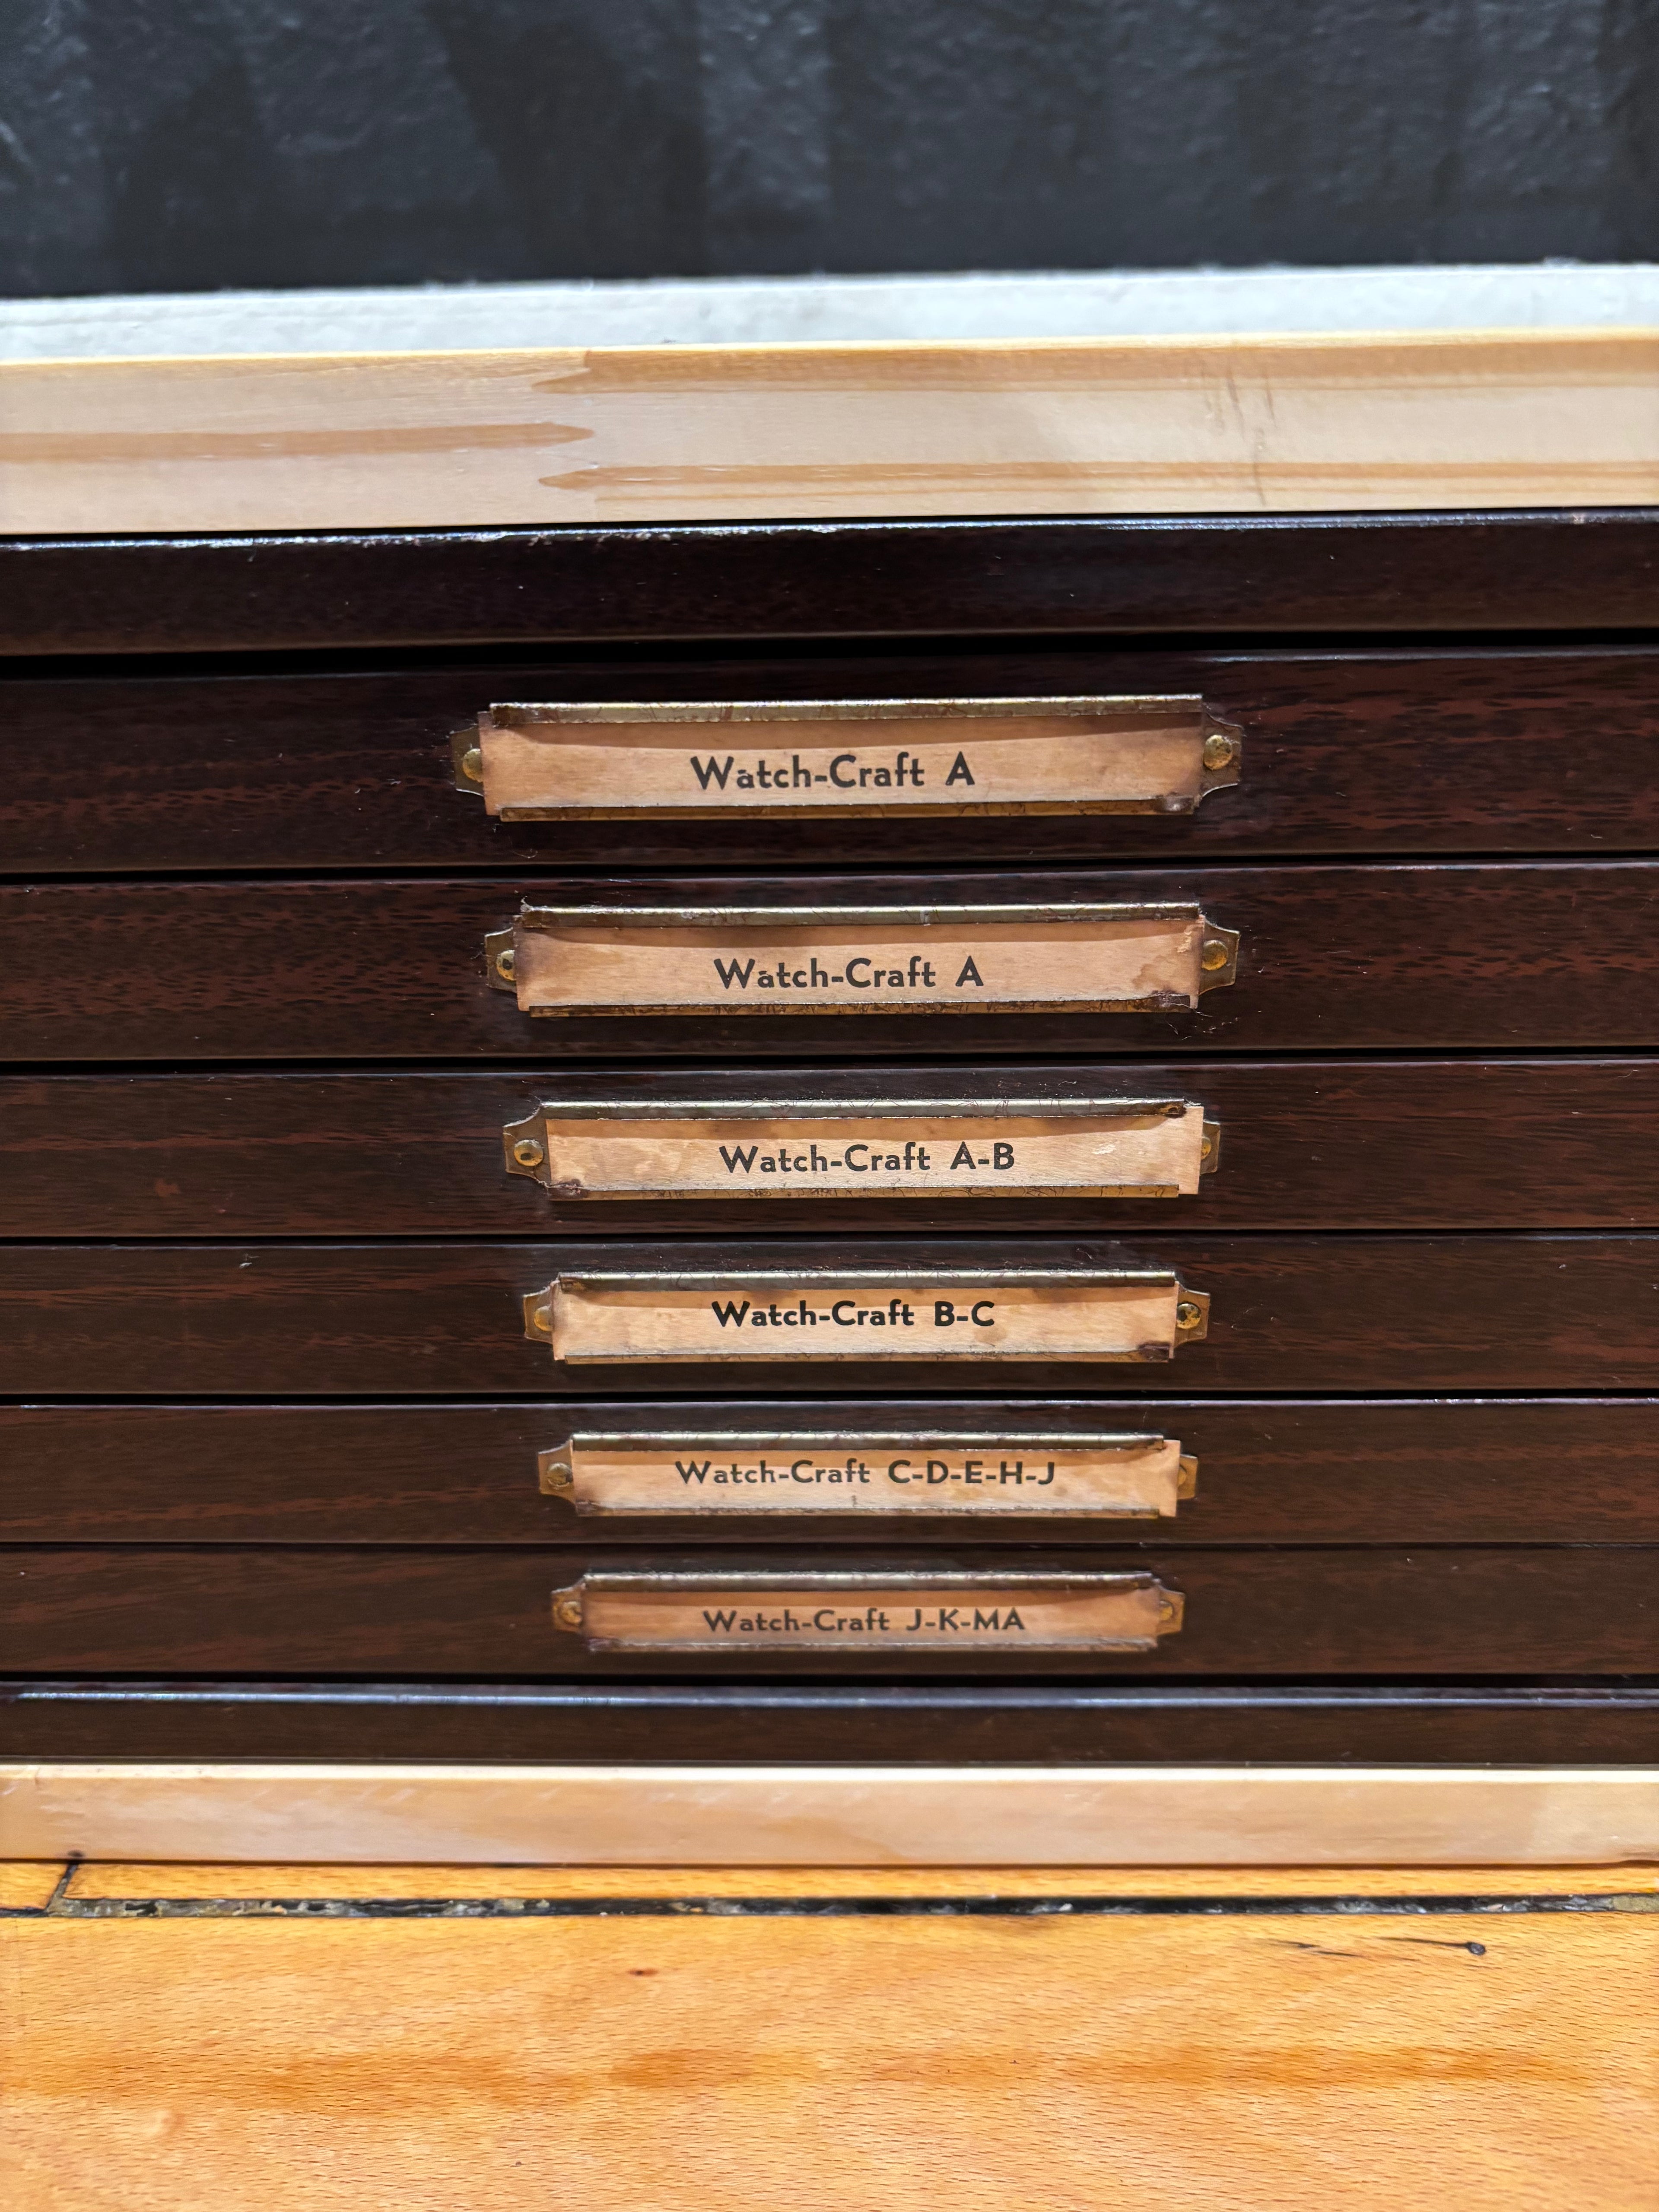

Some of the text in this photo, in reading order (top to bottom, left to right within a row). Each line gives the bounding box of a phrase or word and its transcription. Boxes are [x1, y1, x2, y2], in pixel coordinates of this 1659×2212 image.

[690, 751, 975, 790] Watch-Craft A
[713, 955, 984, 989] Watch-Craft A
[719, 1141, 1014, 1173] Watch-Craft A-B
[711, 1298, 995, 1327] Watch-Craft B-C
[675, 1458, 1055, 1485] Watch-Craft C-D-E-H-J
[703, 1607, 1025, 1632] Watch-Craft J-K-MA
